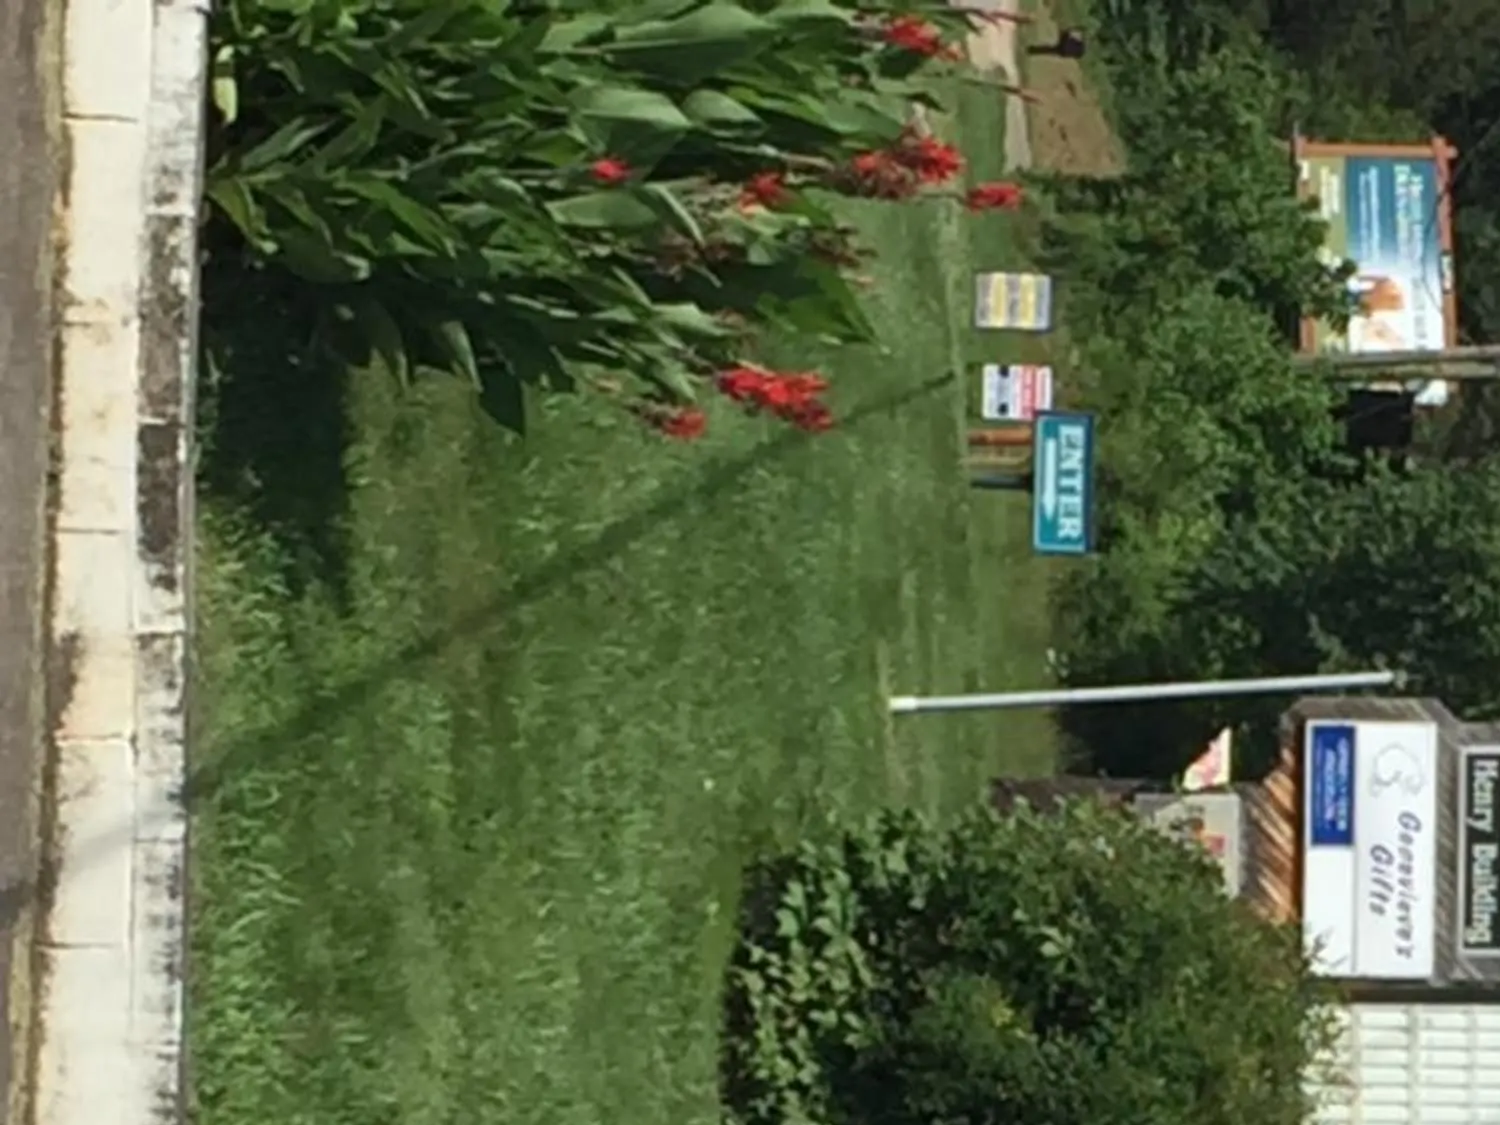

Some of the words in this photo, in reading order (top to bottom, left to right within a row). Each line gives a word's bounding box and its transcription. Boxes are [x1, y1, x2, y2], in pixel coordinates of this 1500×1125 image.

[1057, 424, 1085, 539] ENTER
[1466, 758, 1500, 832] Henry
[1369, 843, 1396, 918] Gifts
[1395, 811, 1422, 960] Genevieve's
[1465, 843, 1500, 943] Building
